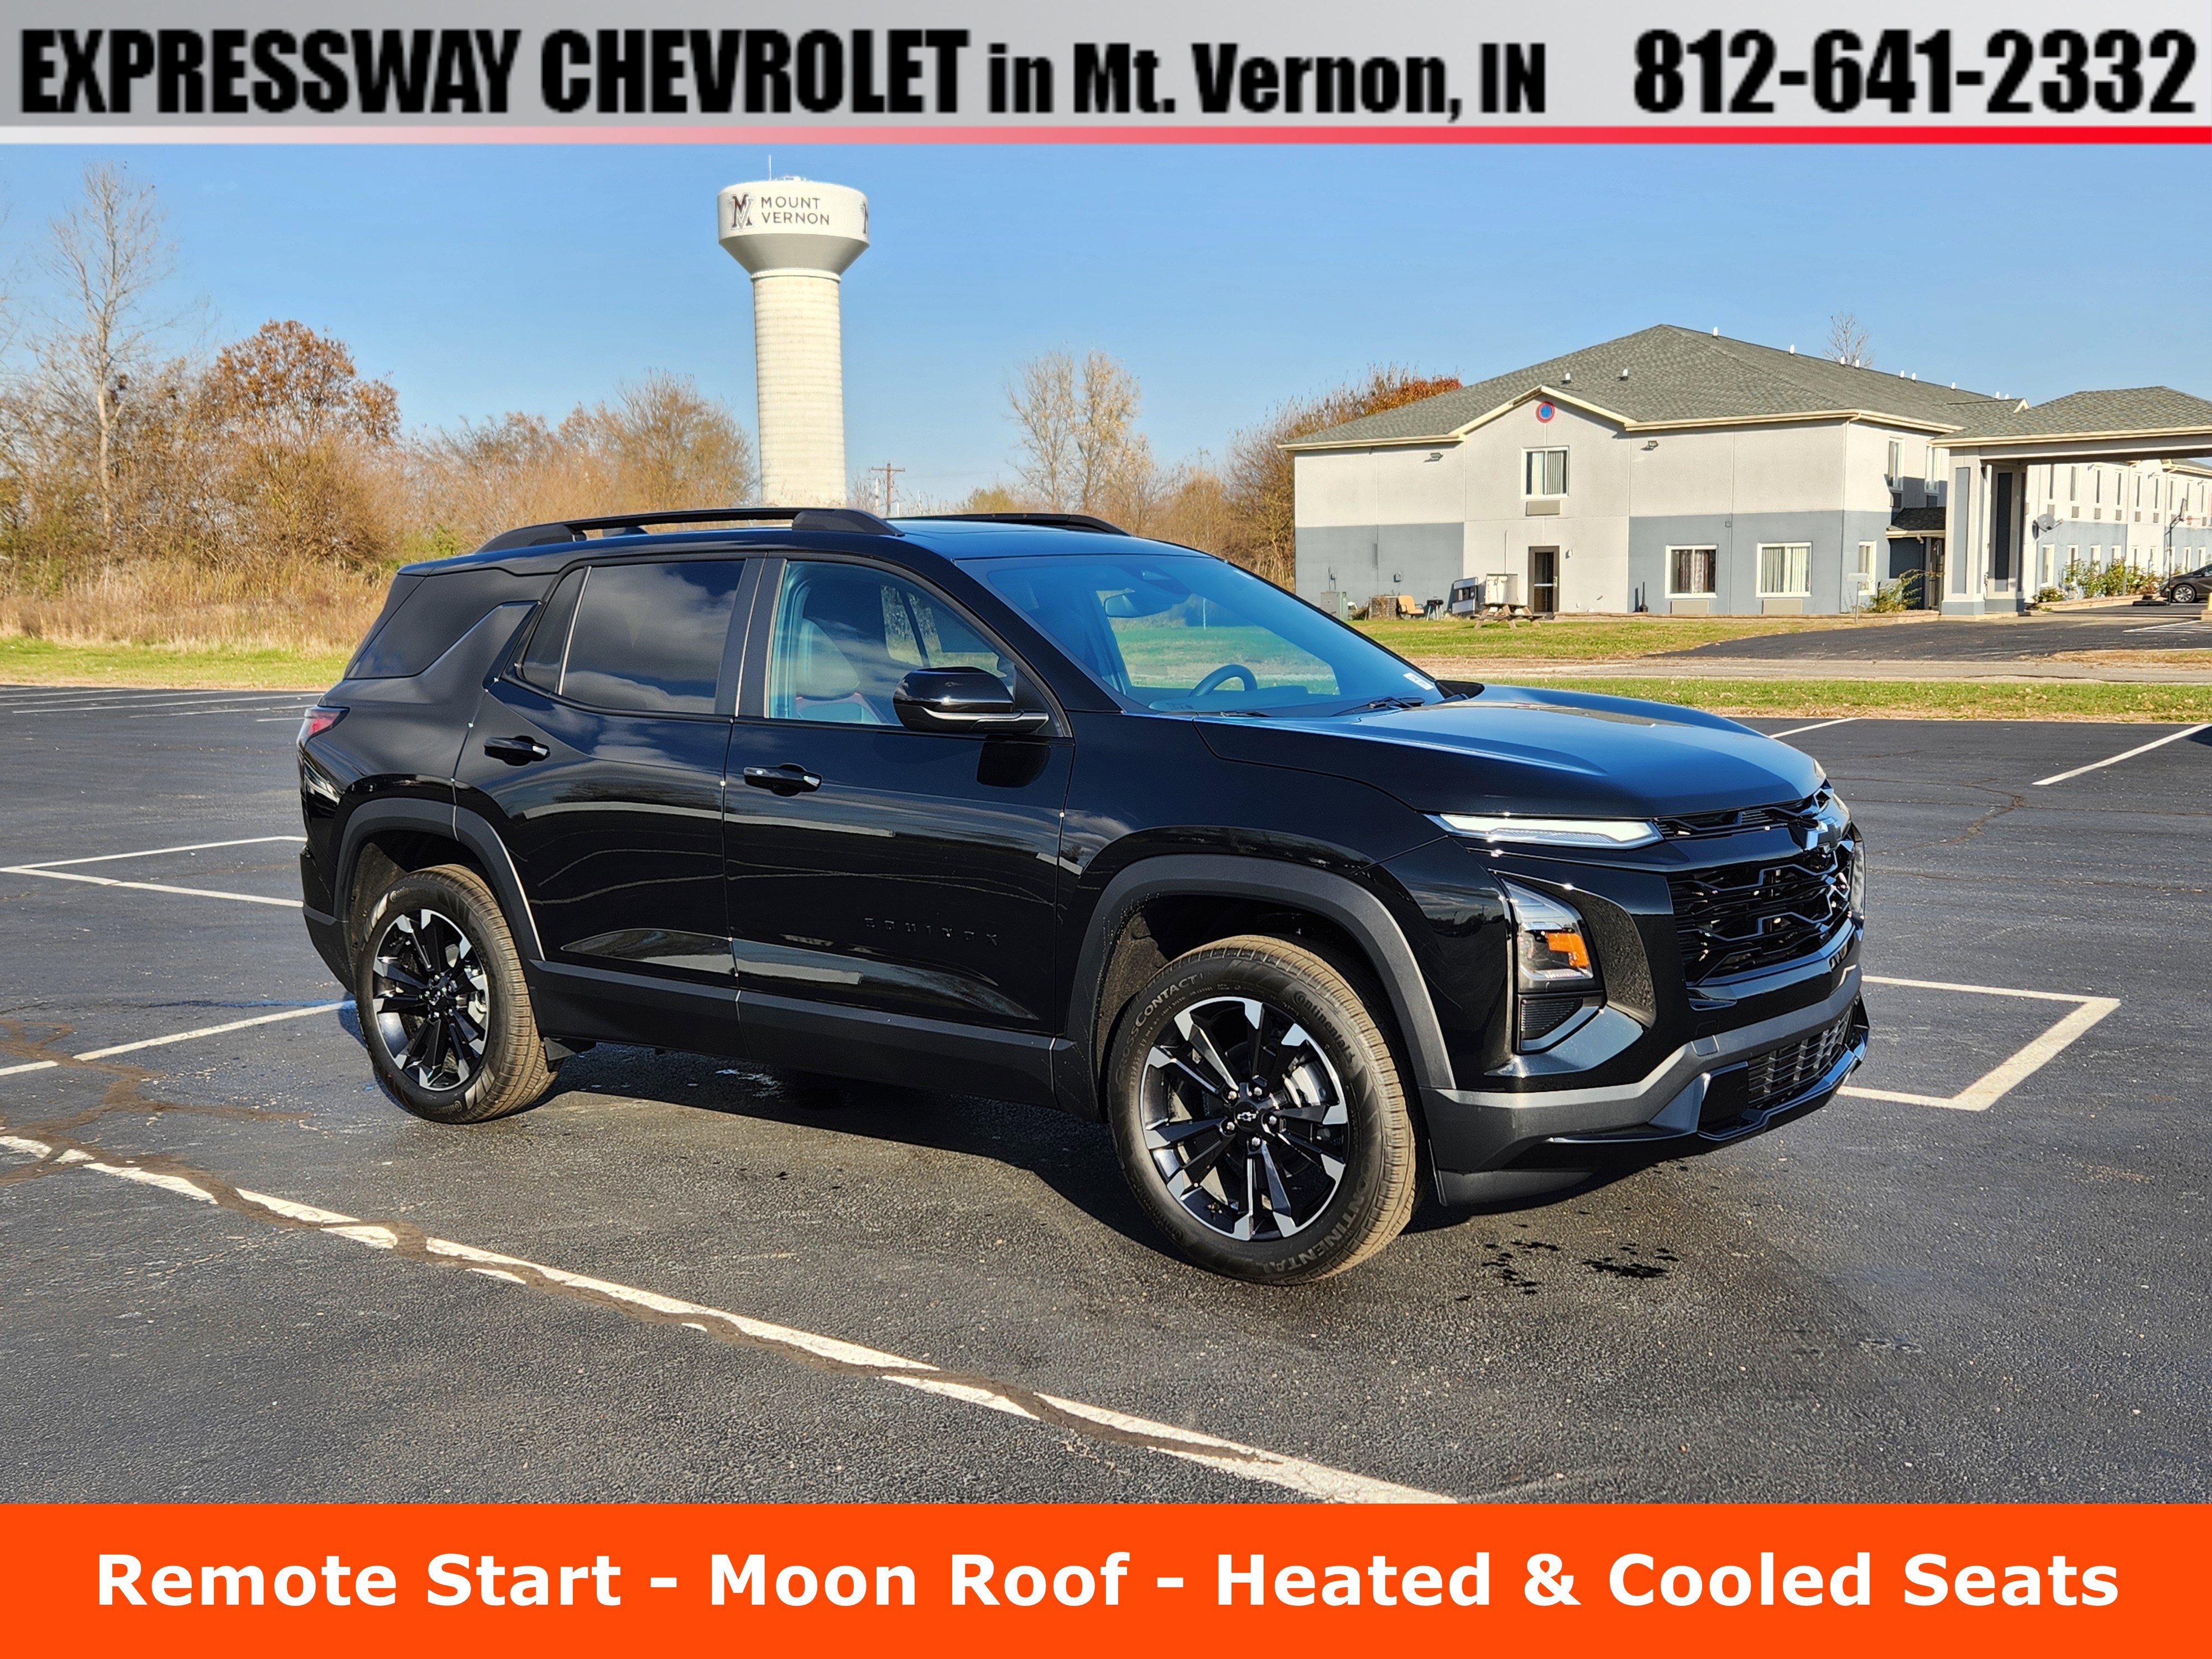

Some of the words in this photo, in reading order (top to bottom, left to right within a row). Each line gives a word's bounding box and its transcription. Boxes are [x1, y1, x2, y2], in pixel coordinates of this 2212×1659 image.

[761, 196, 821, 210] MOUNT
[761, 212, 830, 226] VERNON
[1292, 990, 1352, 1053] Continental
